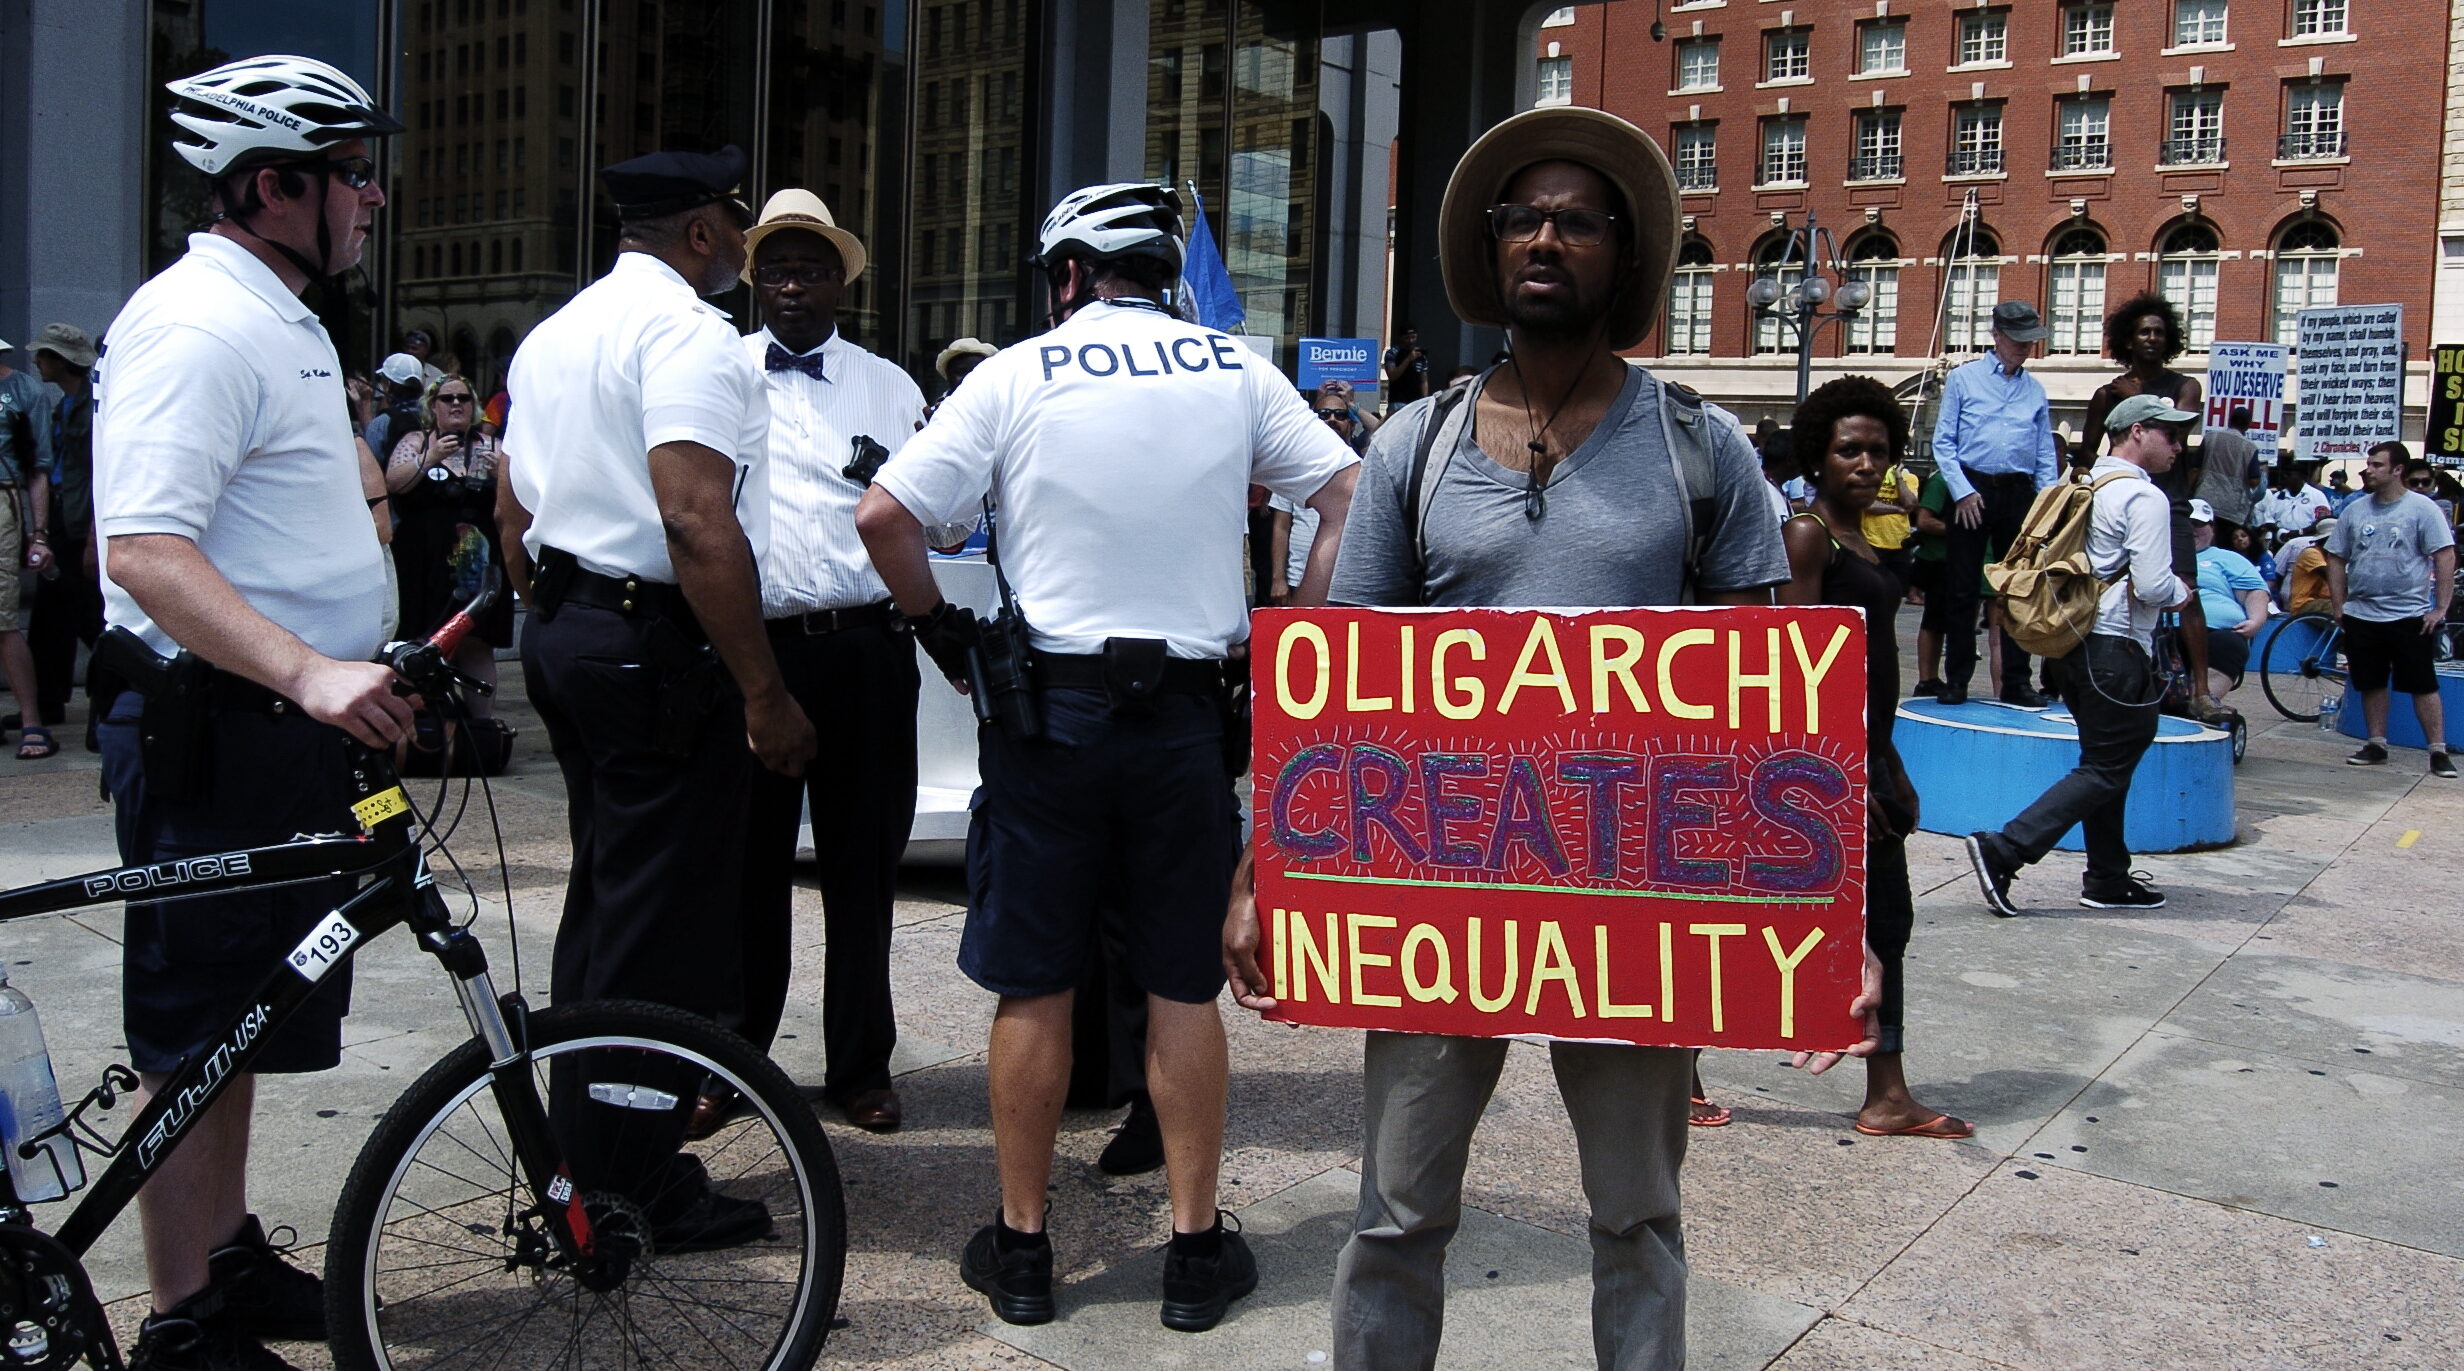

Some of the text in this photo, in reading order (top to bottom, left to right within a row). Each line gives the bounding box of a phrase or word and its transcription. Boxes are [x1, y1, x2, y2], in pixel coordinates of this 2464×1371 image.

[183, 86, 301, 131] PHILADELPHIA POLICE
[2307, 317, 2317, 330] my
[2342, 312, 2362, 325] which
[2363, 315, 2375, 324] are
[2376, 311, 2397, 323] called
[2303, 331, 2311, 345] by
[2313, 333, 2324, 344] my
[2349, 328, 2367, 340] shall
[2368, 327, 2395, 339] humble
[1040, 334, 1244, 382] POLICE
[1310, 346, 1368, 361] Bernie
[2218, 348, 2279, 358] ASK ME
[2345, 344, 2359, 356] and
[2229, 359, 2266, 368] WHY
[2301, 362, 2317, 374] seek
[2318, 364, 2330, 376] my
[2348, 361, 2362, 372] and
[2363, 361, 2378, 372] turn
[2380, 360, 2396, 372] from
[2210, 370, 2284, 398] YOU DESERVE
[2301, 377, 2320, 389] their
[2321, 377, 2350, 389] wicked
[2378, 376, 2396, 388] then
[2301, 393, 2316, 405] will
[2322, 393, 2341, 405] hear
[2342, 391, 2362, 405] from
[2301, 408, 2316, 421] and
[2317, 408, 2331, 420] will
[2332, 408, 2358, 423] forgive
[2361, 408, 2380, 420] their
[2300, 424, 2315, 436] and
[2317, 424, 2332, 436] will
[2333, 424, 2351, 436] heal
[2353, 424, 2373, 436] their
[2313, 441, 2319, 453] 2
[2320, 441, 2360, 453] Chronicles
[1274, 616, 1851, 735] OLIGARCHY
[1270, 741, 1851, 894] CREATES
[85, 853, 252, 898] POLICE
[311, 922, 352, 964] 193
[1273, 908, 1826, 1039] INEQUALITY
[137, 1003, 268, 1170] FUJI USA
